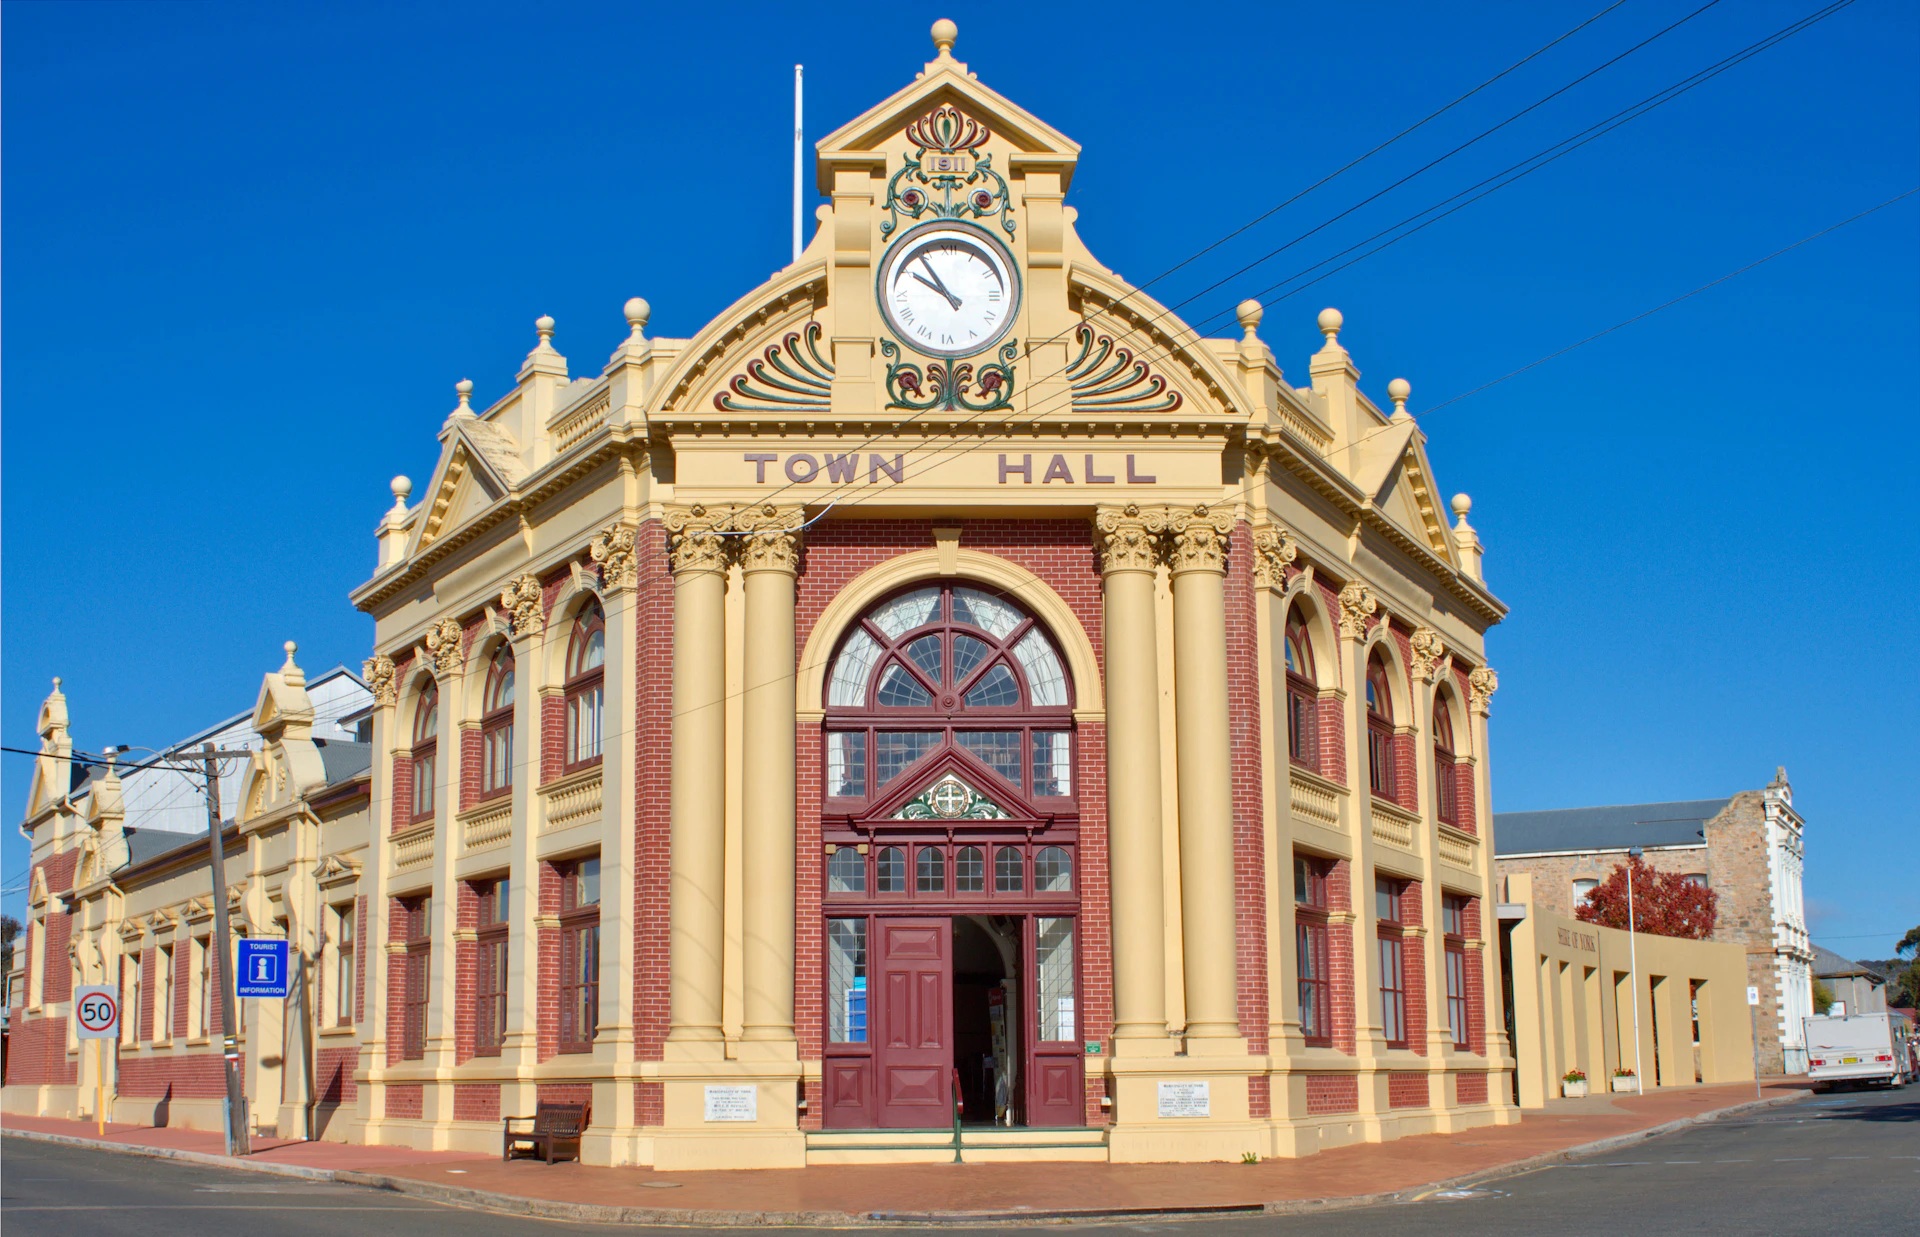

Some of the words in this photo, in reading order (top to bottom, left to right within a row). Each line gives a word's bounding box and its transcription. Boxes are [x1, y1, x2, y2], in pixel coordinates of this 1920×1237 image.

[931, 157, 966, 171] 1911
[744, 453, 904, 484] TOWN
[998, 454, 1156, 484] HALL
[250, 943, 278, 951] TOURIST
[1571, 931, 1578, 949] OF
[1579, 933, 1596, 952] YORK
[84, 1003, 111, 1022] 50
